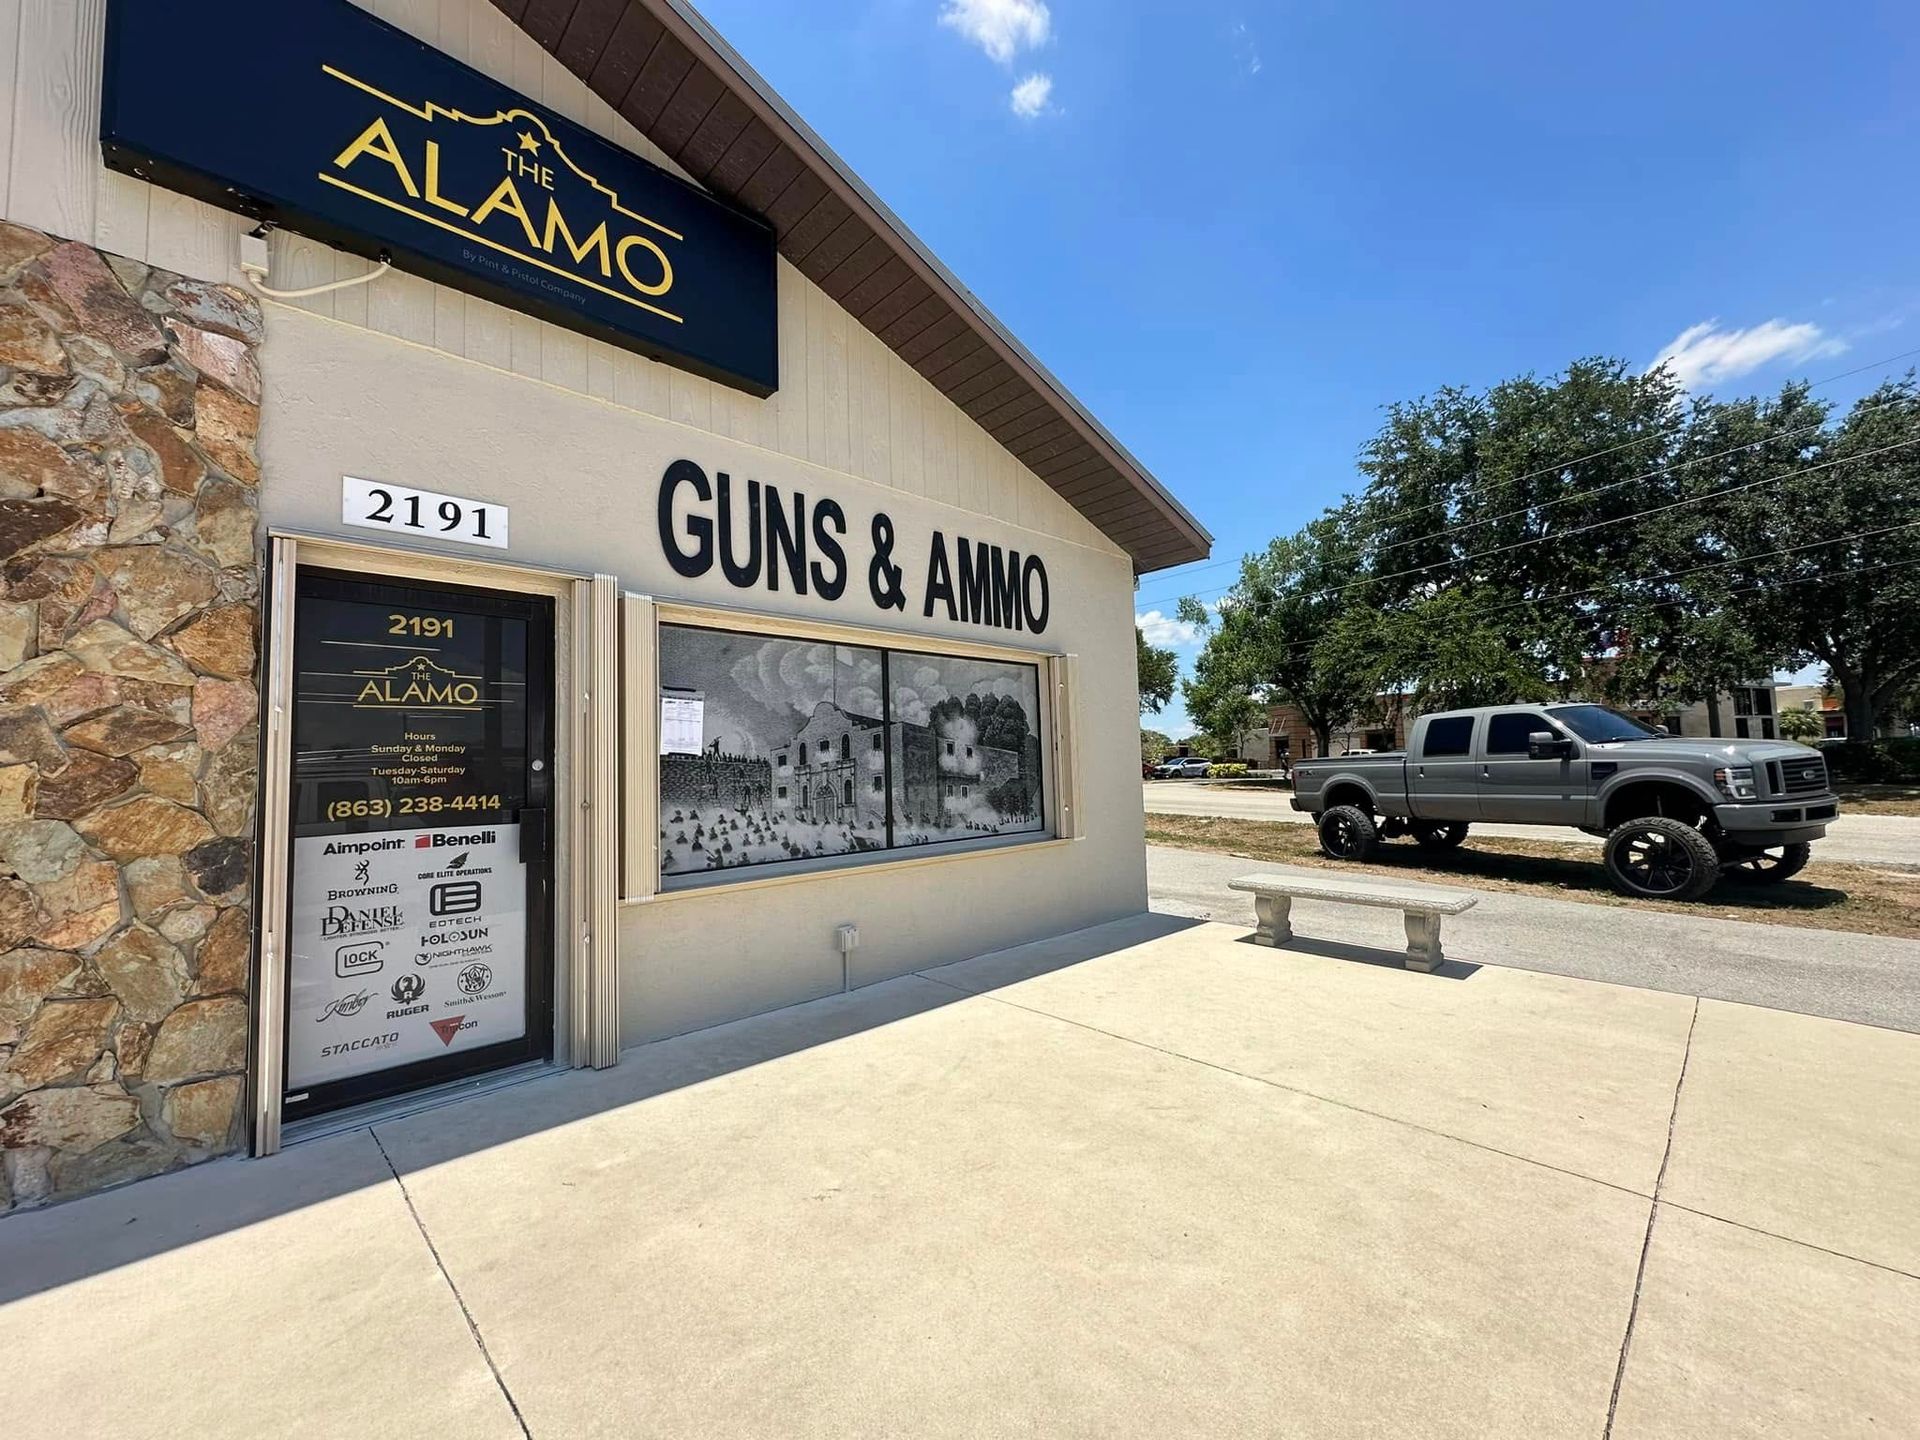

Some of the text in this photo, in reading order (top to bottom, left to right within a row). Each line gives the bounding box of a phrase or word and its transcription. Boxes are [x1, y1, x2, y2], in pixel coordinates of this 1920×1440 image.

[501, 147, 555, 191] THE
[333, 116, 674, 296] ALAMO
[463, 249, 586, 305] By Pint & Pistol Company
[365, 488, 493, 540] 2191
[658, 458, 1050, 636] GUNS & AMMO
[388, 614, 453, 638] 2191
[411, 672, 431, 681] THE
[357, 680, 478, 705] ALAMO
[404, 732, 436, 741] Hours
[371, 744, 466, 755] Sunday & Monday
[402, 754, 438, 763] Closed
[370, 766, 466, 776] Tuesday-Saturday
[391, 775, 447, 786] 10am-6pm
[327, 795, 501, 822] (863) 238-4414
[323, 838, 405, 856] Aimpoint
[432, 831, 496, 847] Benelli
[418, 867, 492, 880] CORE ELITE OPERATIONS
[327, 883, 398, 901] BROWNING
[429, 916, 482, 928] EOTECH
[421, 927, 489, 947] HOLOSUN
[433, 944, 493, 959] NIGHTHAWK
[386, 1004, 430, 1020] RUGER
[320, 1032, 399, 1058] STACCATO
